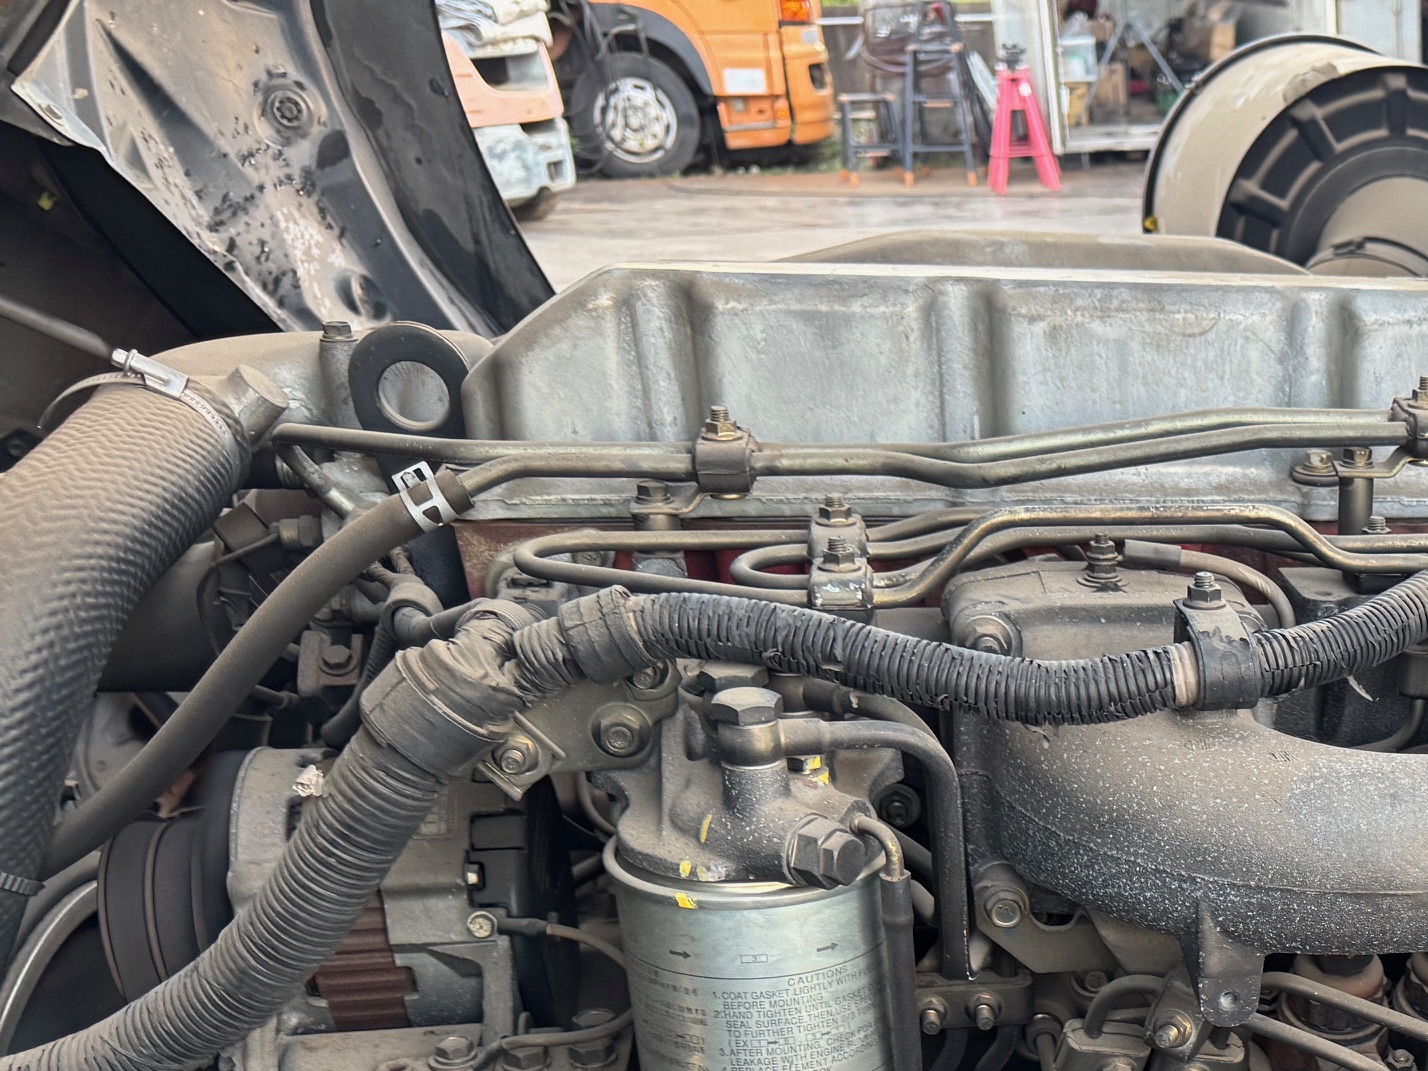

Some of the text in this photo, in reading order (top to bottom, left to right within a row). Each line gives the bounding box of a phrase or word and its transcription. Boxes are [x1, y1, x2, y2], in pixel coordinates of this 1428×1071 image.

[750, 988, 790, 1000] GASKET
[793, 980, 833, 996] LIGHTLY
[836, 971, 858, 985] WITH
[787, 965, 848, 986] CAUTIONS
[723, 1000, 766, 1010] BEFORE
[756, 1006, 802, 1019] TIGHTEN
[804, 1000, 833, 1013] UNTIL
[834, 985, 867, 1005] GASKET
[725, 1020, 753, 1029] SEAL
[726, 1029, 742, 1039] TO
[744, 1026, 794, 1039] FURTHER
[796, 1017, 839, 1033] TIGHTEN
[826, 1031, 856, 1046] CHECK
[730, 1056, 779, 1067] LEAKAGE
[781, 1053, 807, 1065] WITH
[810, 1042, 846, 1059] ENGINE
